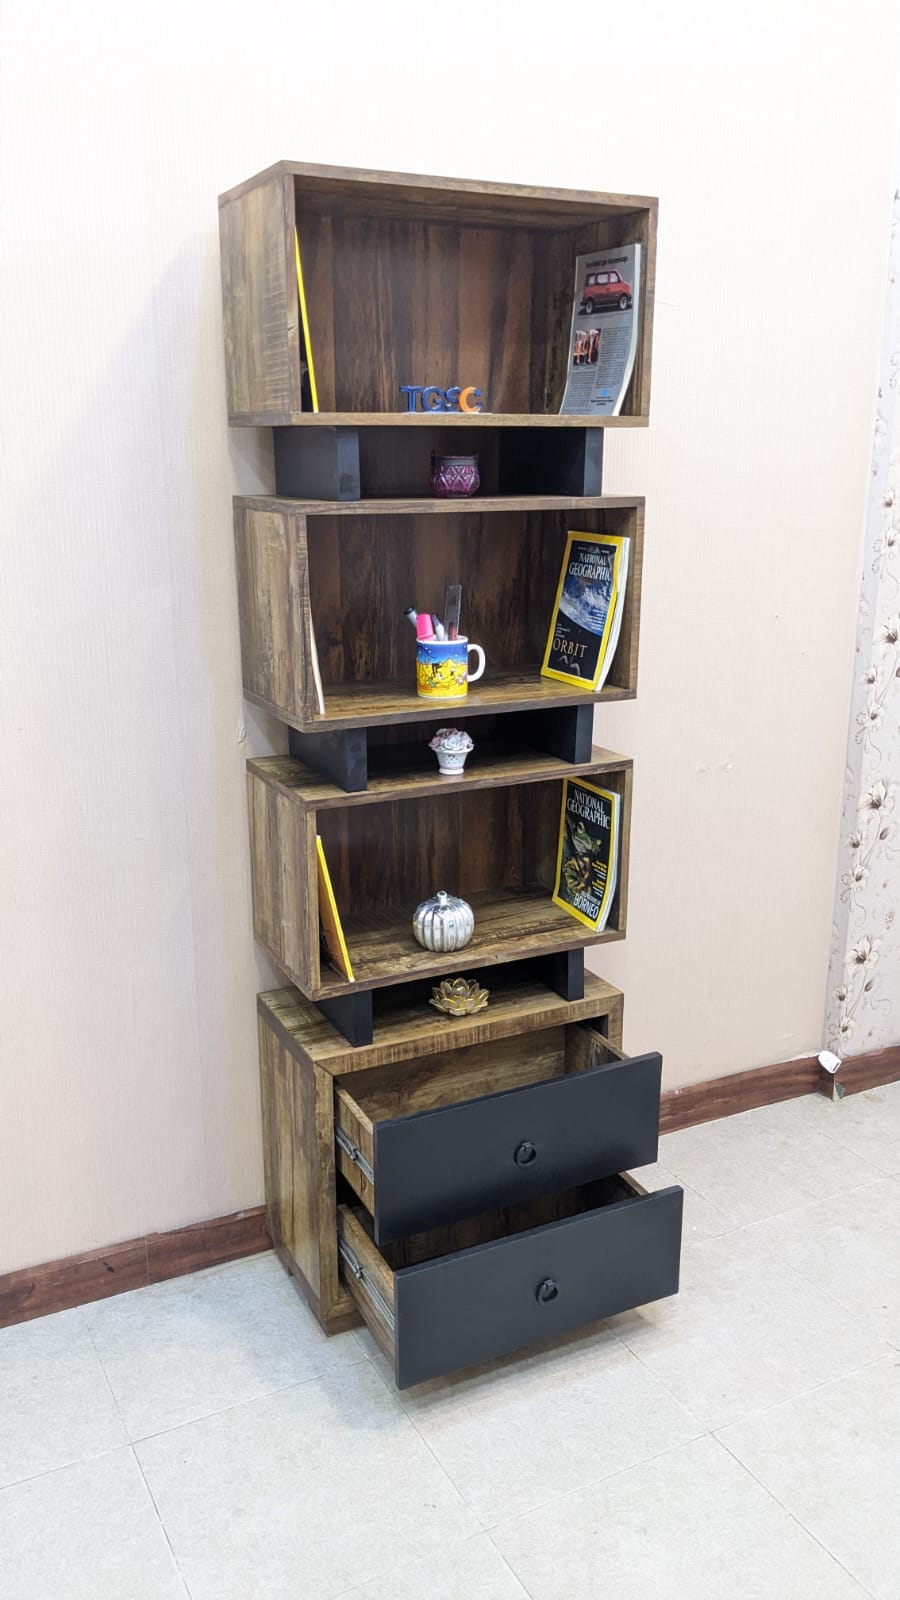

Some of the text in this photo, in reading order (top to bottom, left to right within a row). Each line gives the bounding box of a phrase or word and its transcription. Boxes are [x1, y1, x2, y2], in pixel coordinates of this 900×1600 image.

[399, 385, 482, 413] TGSC
[579, 553, 606, 566] NATIONAL
[553, 637, 588, 658] ORBIT
[574, 788, 604, 813] NATIONAL
[567, 798, 611, 829] GEOGRAPHIC
[573, 893, 599, 919] BORNEO
